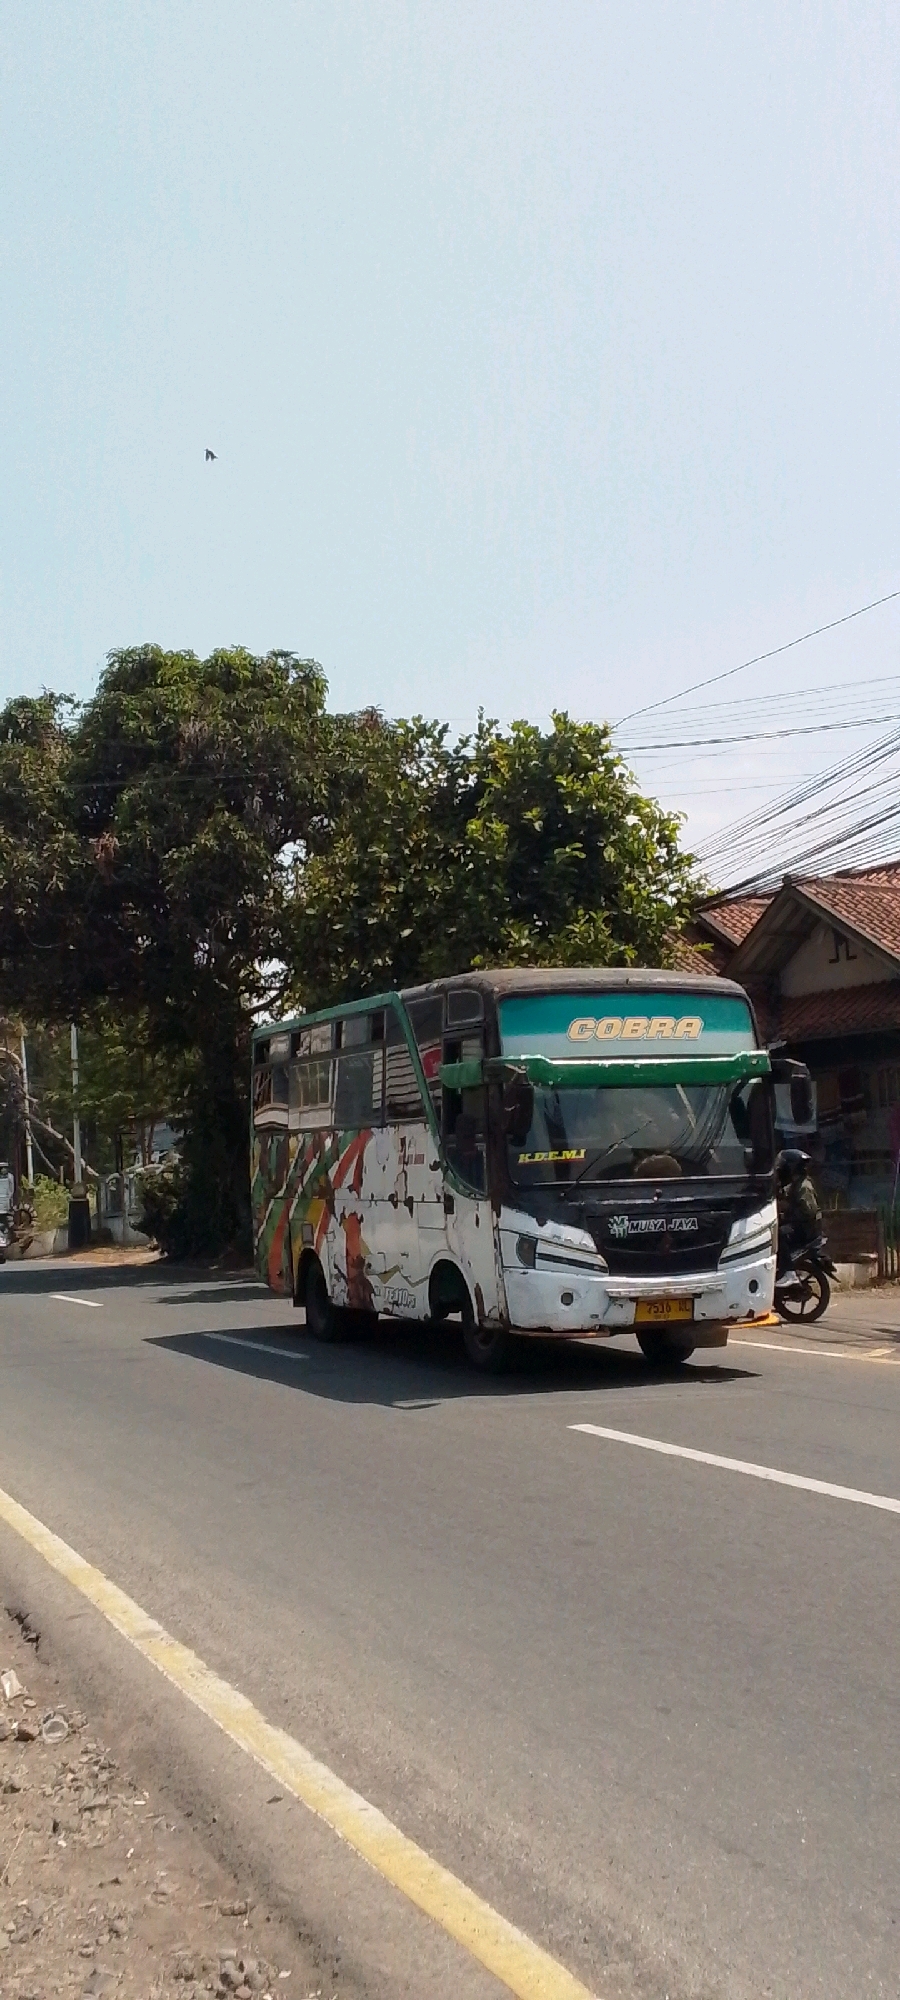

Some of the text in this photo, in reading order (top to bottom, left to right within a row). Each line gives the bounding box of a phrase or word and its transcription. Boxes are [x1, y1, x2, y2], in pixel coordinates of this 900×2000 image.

[567, 1017, 704, 1041] COBRA
[628, 1219, 666, 1233] MULYA
[667, 1217, 699, 1231] JAYA
